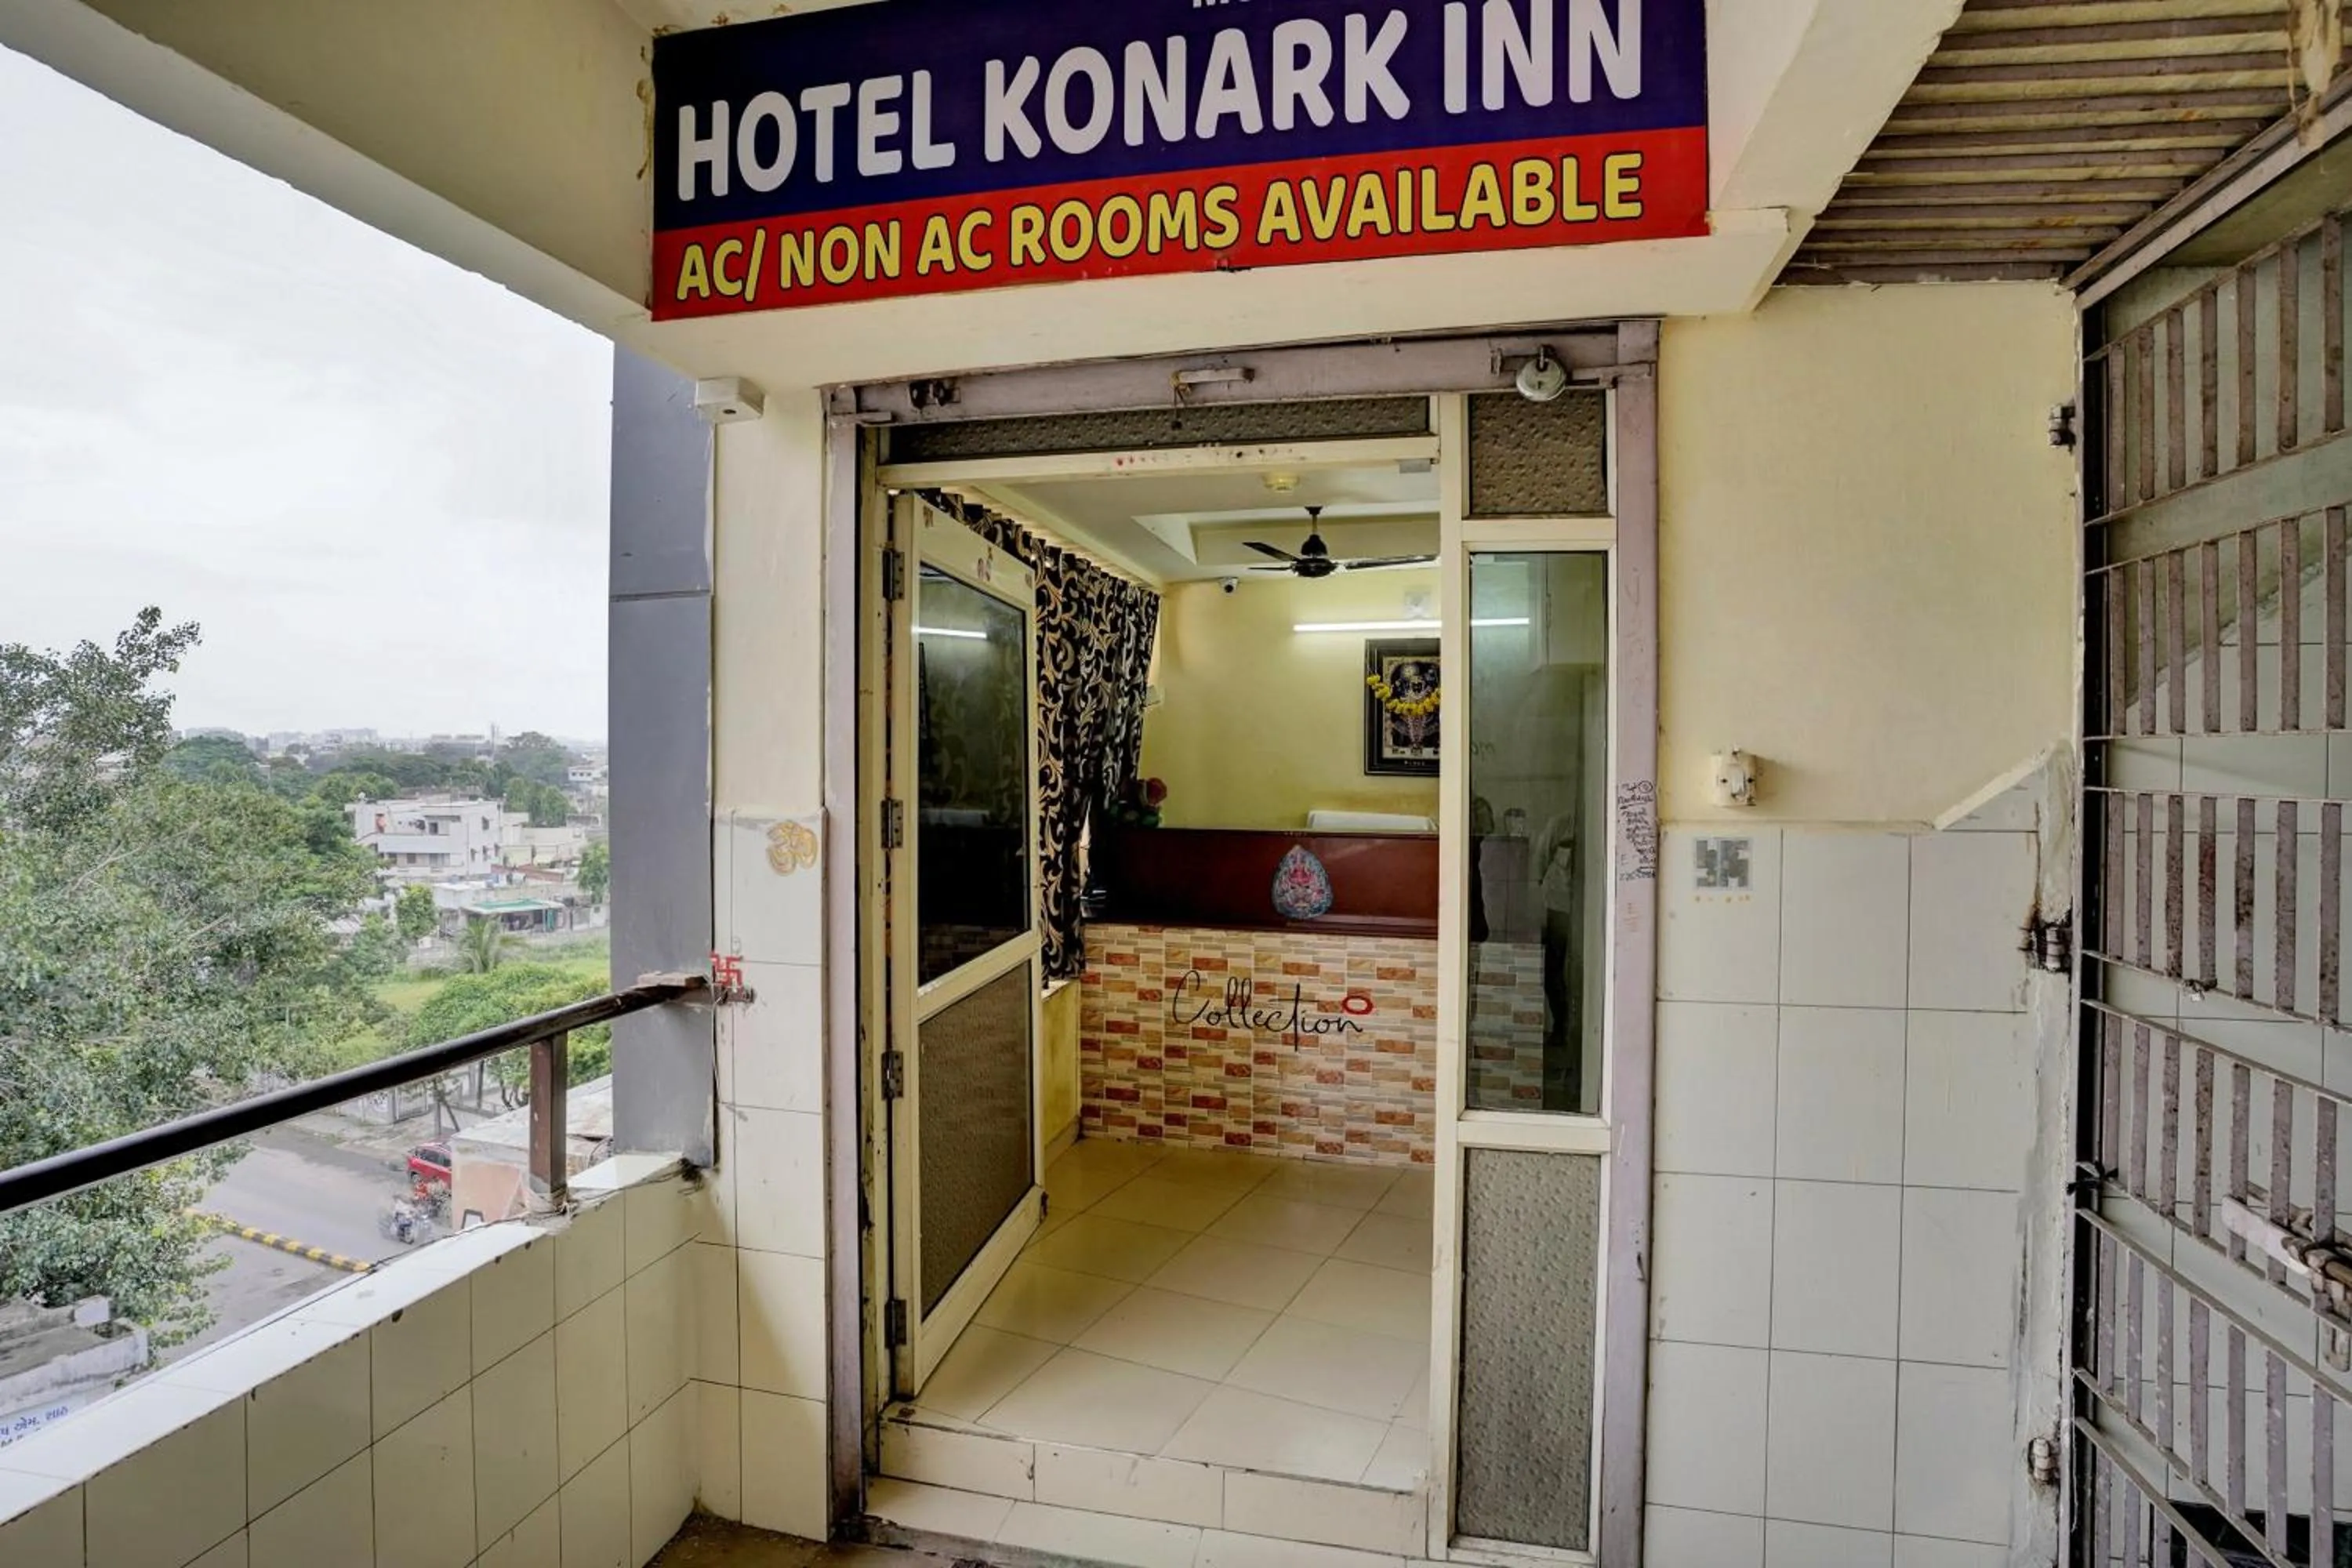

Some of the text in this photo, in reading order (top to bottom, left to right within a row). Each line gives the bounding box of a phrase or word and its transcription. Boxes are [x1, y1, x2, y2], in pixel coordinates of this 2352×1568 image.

[677, 0, 1642, 201] HOTEL KONARK INN
[676, 153, 1642, 302] AC/ NON AC ROOMS AVAILABLE
[1173, 970, 1363, 1052] Collection
